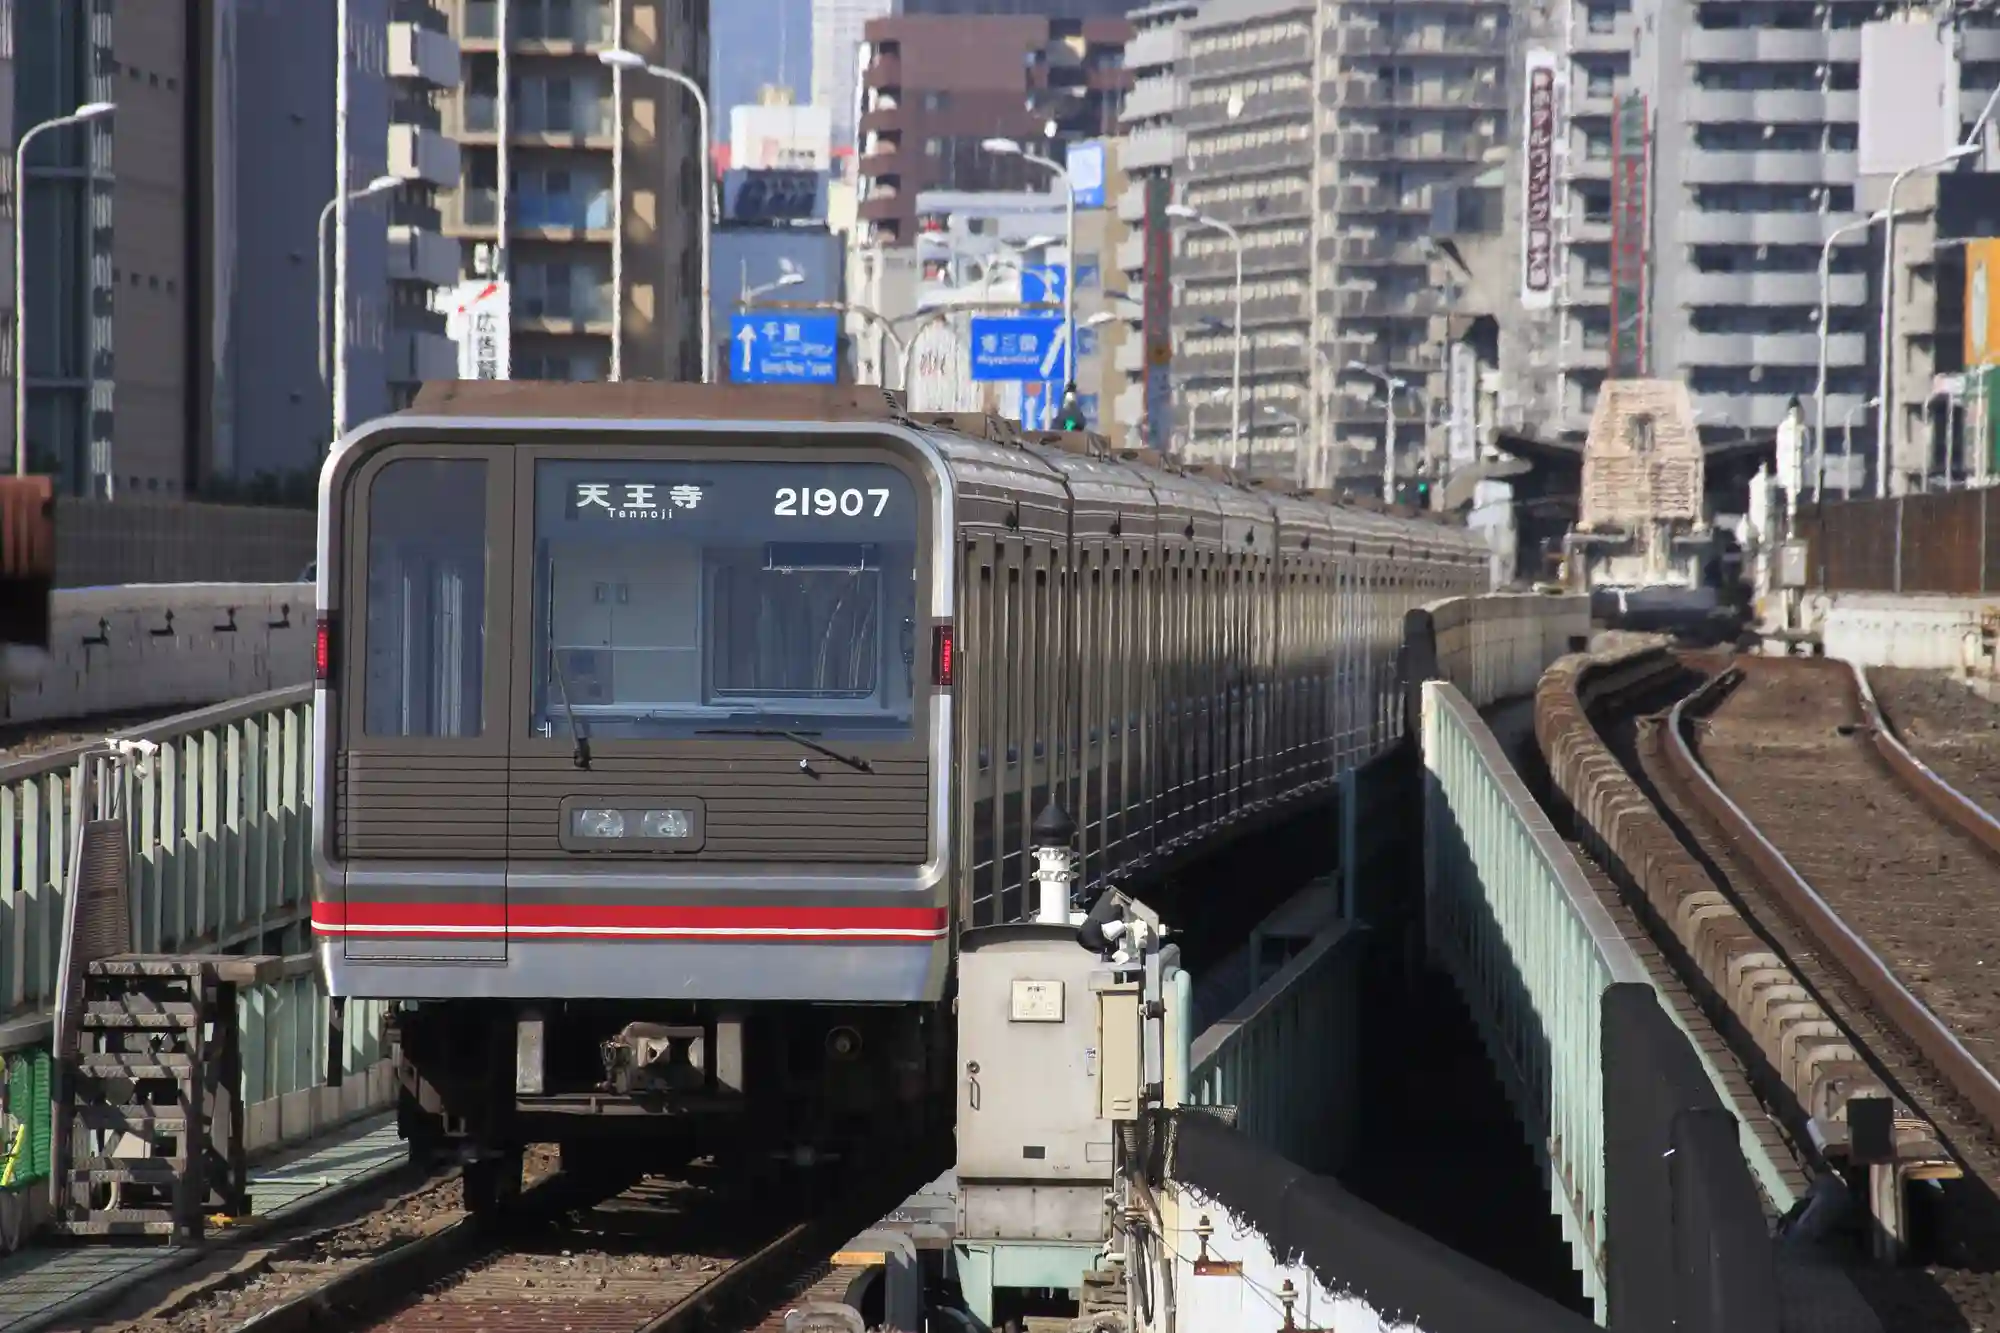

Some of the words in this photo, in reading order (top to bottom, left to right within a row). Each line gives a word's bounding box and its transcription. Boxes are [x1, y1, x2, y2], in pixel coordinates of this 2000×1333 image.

[576, 484, 703, 509] 天王寺
[774, 487, 891, 518] 21907
[607, 507, 673, 520] Tennoji
